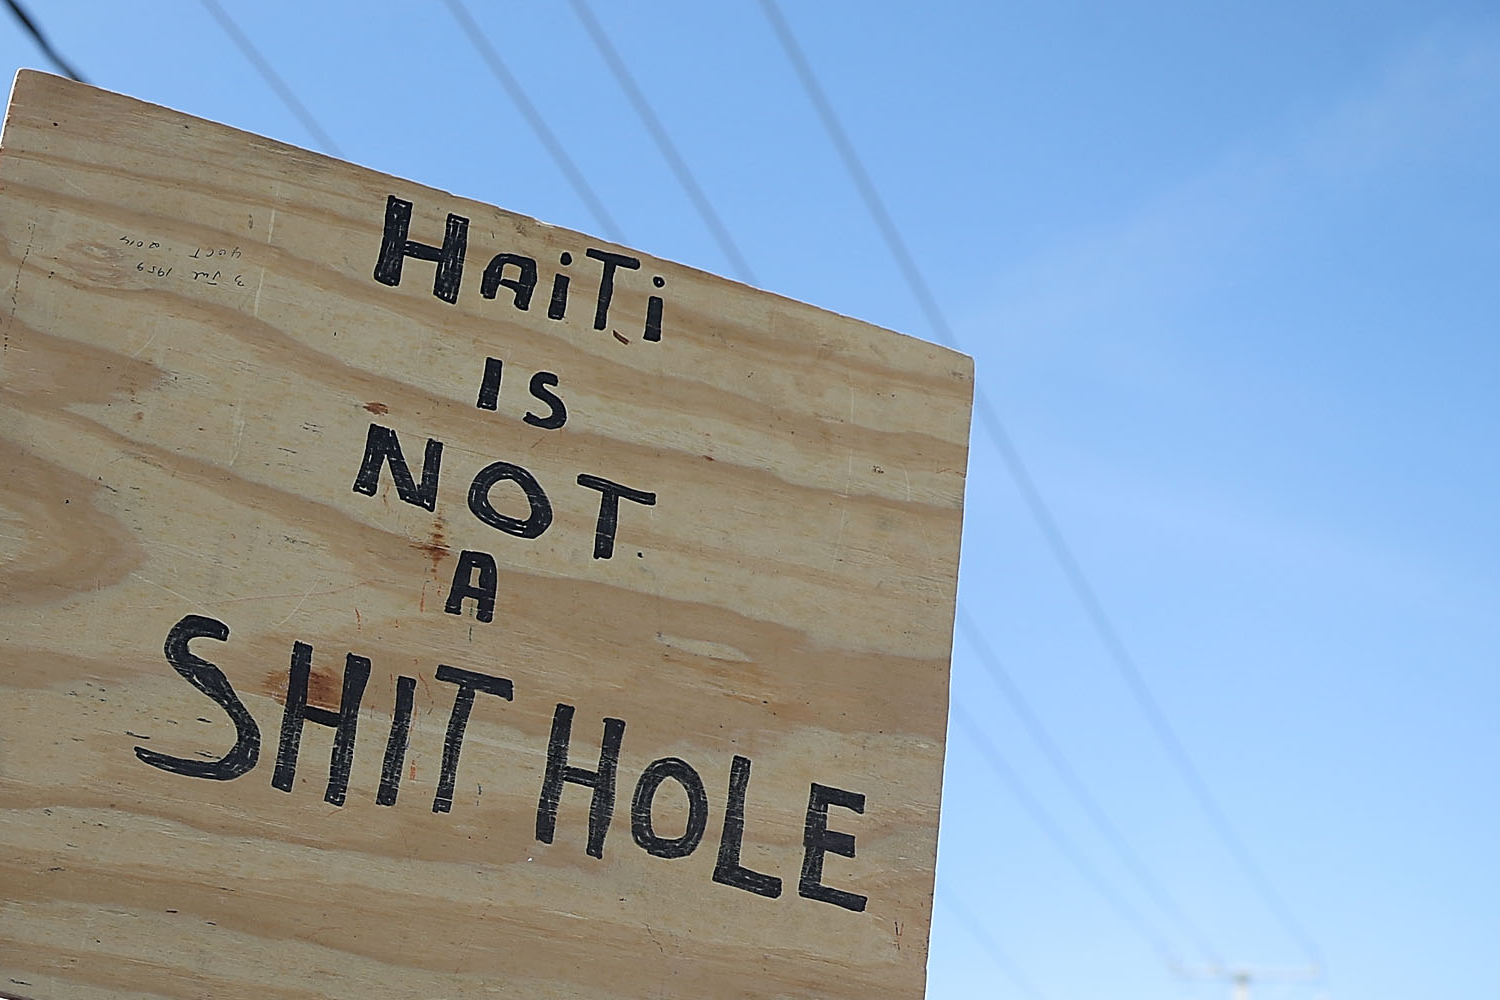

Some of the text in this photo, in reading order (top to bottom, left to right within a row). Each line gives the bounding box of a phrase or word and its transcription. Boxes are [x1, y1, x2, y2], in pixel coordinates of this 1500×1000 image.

[136, 262, 173, 278] 1959
[476, 357, 568, 430] IS
[353, 423, 657, 559] NOT
[444, 549, 498, 623] A
[133, 614, 868, 913] SHIT HOLE
